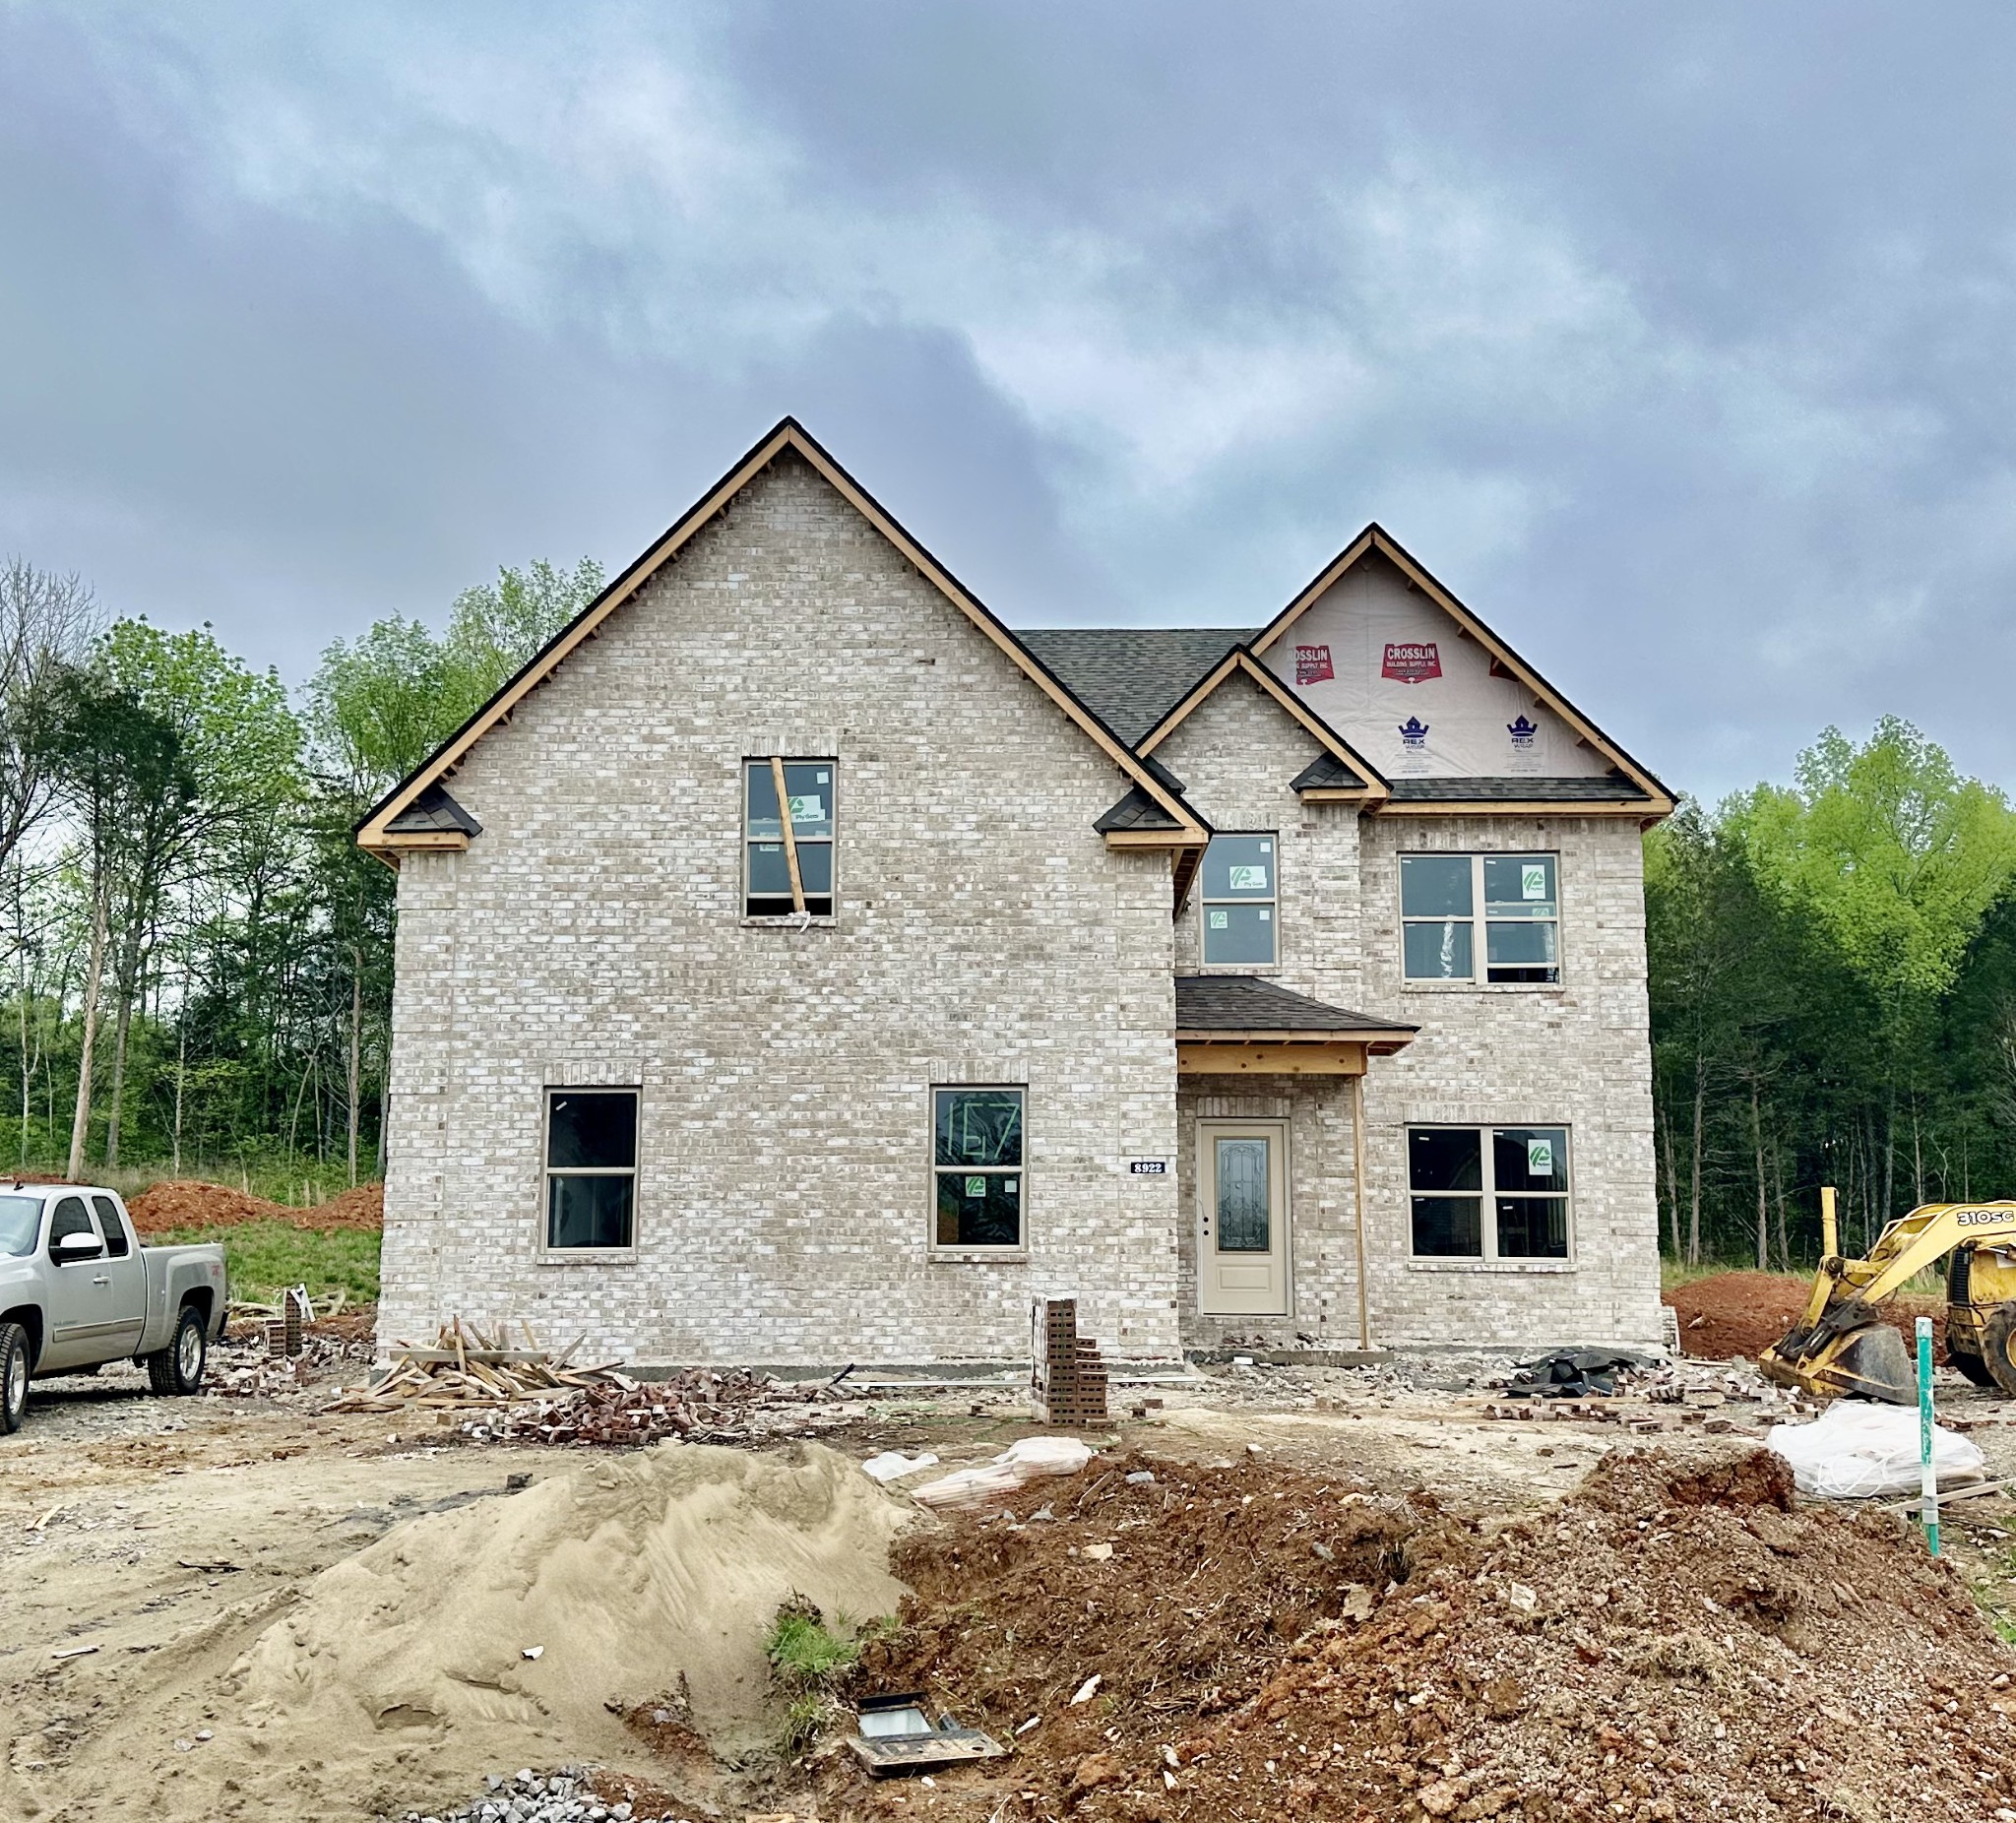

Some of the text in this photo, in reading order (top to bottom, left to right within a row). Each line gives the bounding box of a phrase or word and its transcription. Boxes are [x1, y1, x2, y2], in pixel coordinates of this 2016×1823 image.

[1387, 647, 1435, 660] CROSSLIN
[1134, 1163, 1163, 1173] 8922
[1957, 1211, 2014, 1226] 310SG
